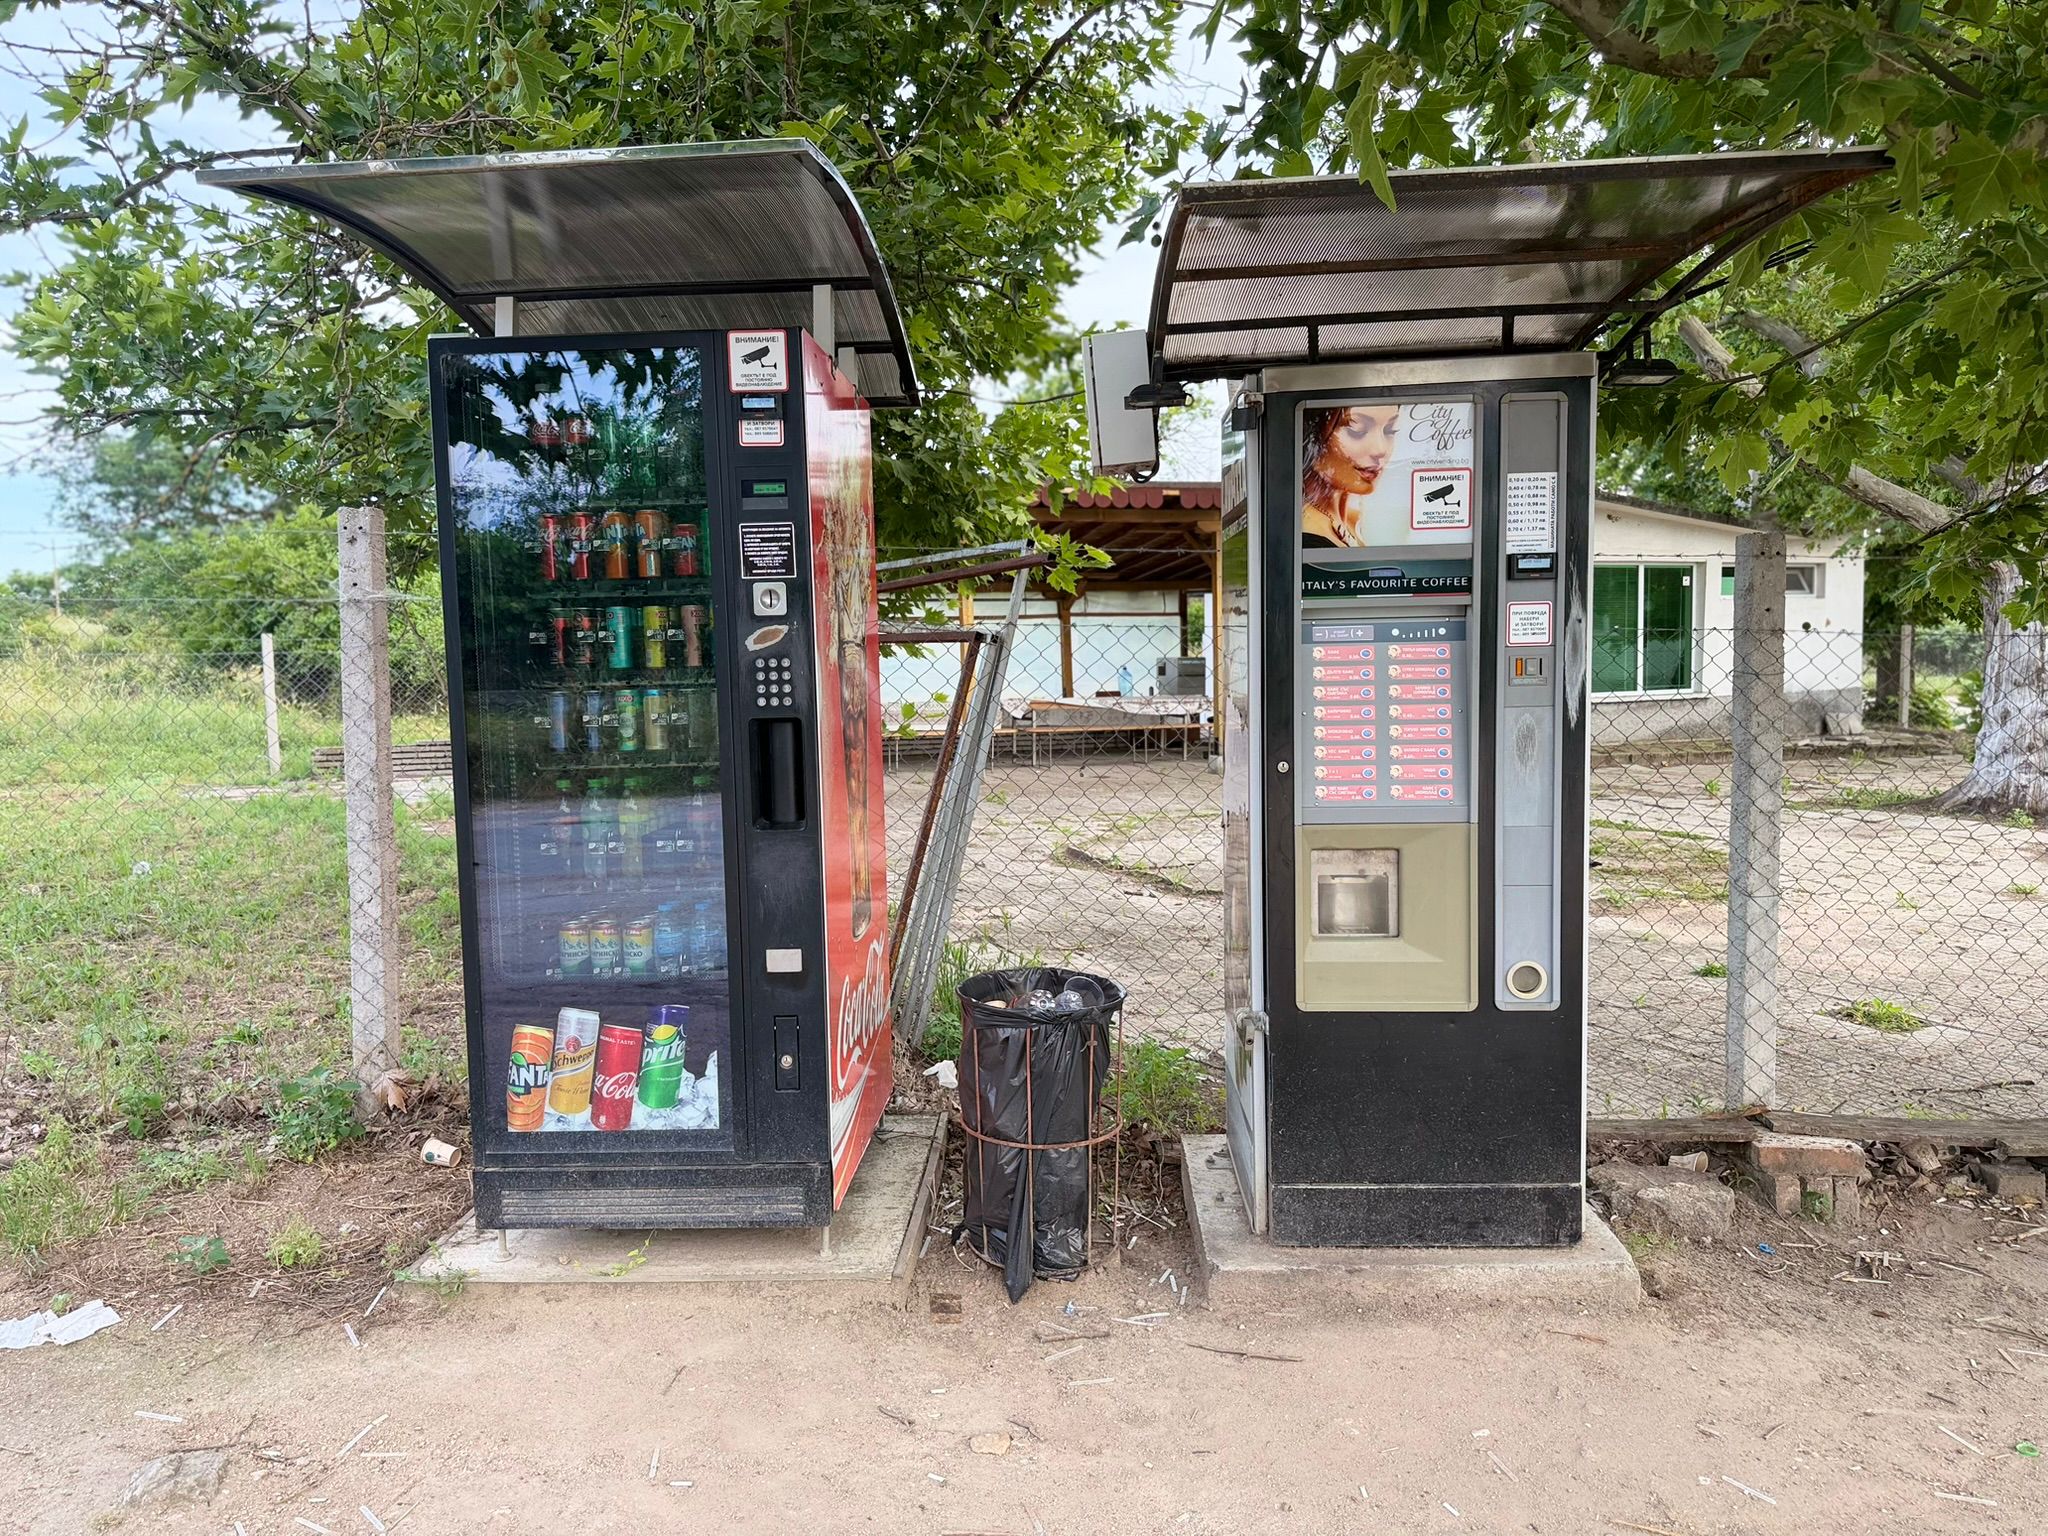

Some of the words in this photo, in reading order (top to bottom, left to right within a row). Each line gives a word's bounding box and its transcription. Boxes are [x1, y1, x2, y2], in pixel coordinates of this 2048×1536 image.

[735, 336, 779, 344] ВНИМАНИЕ!
[1410, 403, 1453, 430] City
[1409, 419, 1472, 451] Coffee
[1302, 580, 1346, 590] ITALY'S
[1351, 578, 1417, 589] FAVOURITE
[1422, 577, 1468, 587] COFFEE
